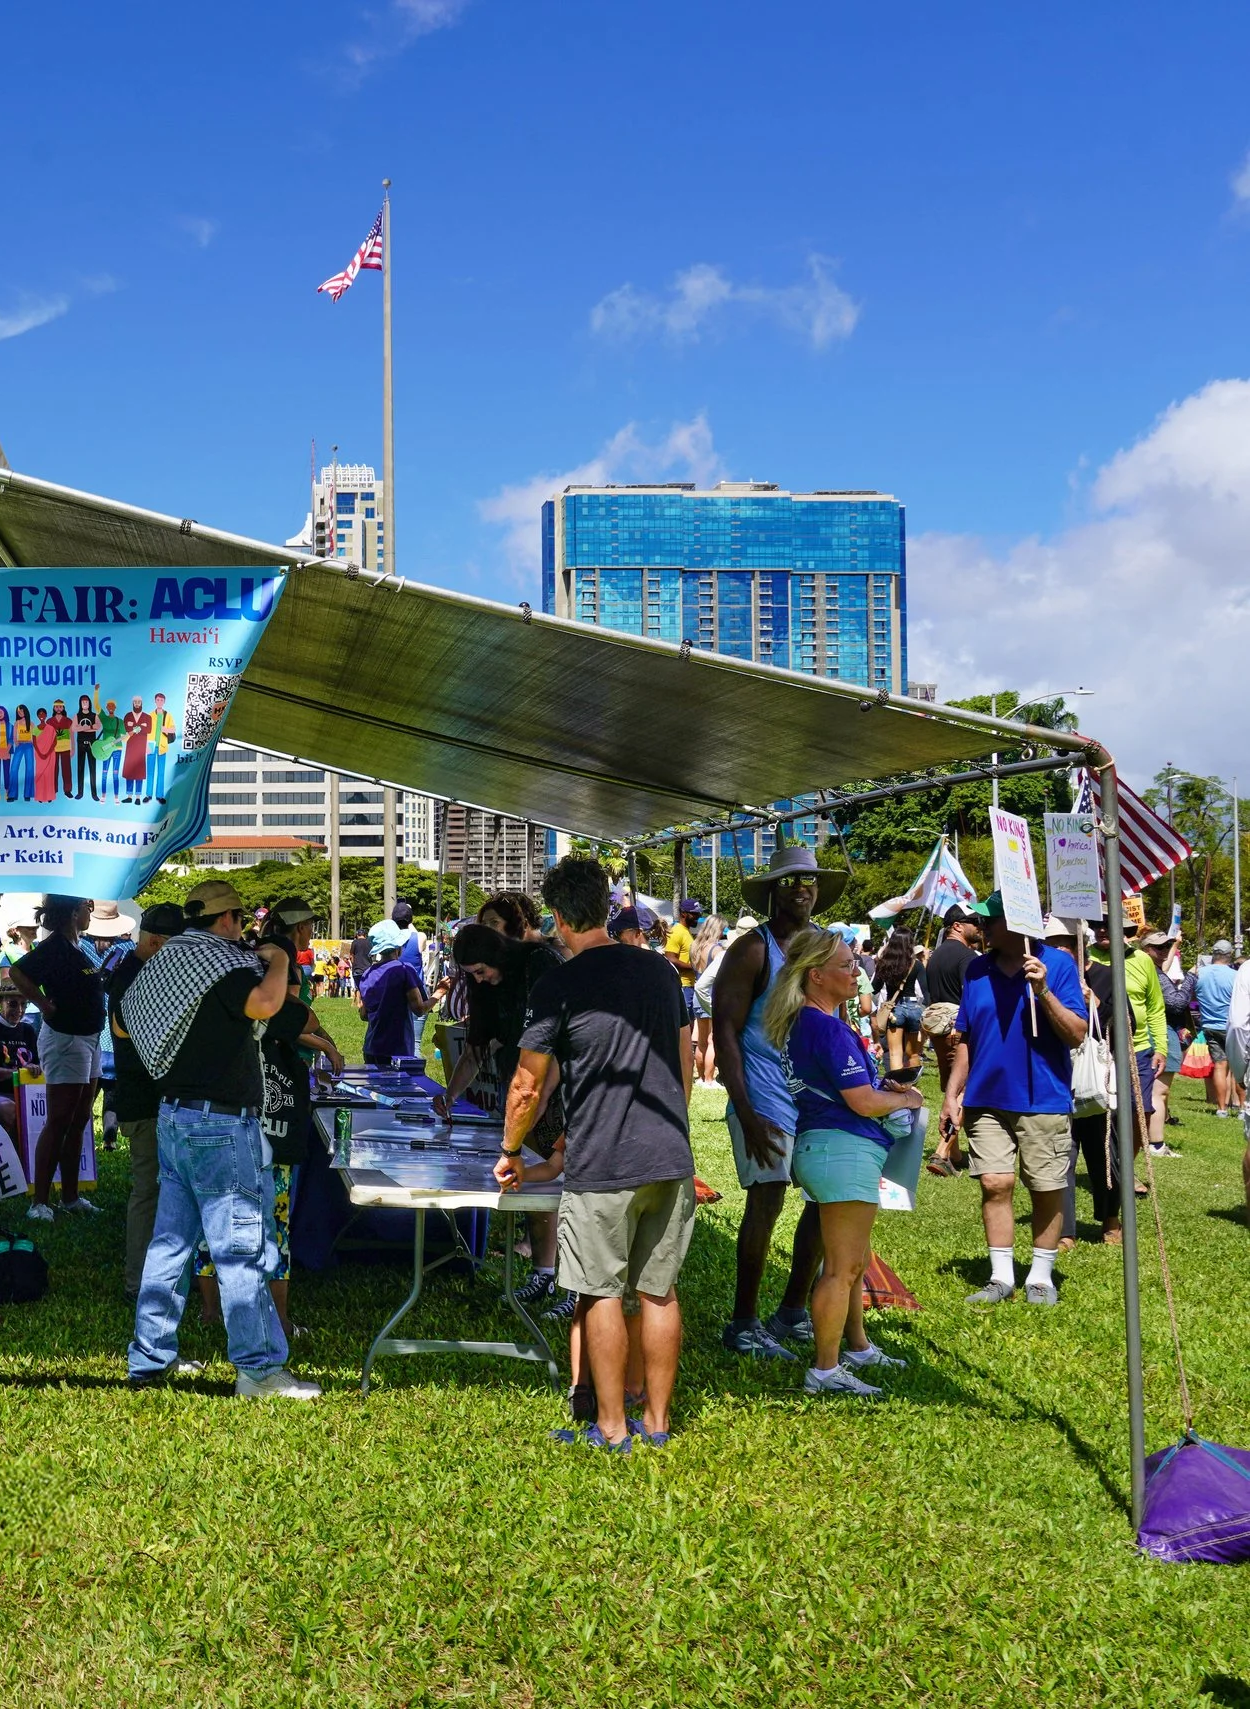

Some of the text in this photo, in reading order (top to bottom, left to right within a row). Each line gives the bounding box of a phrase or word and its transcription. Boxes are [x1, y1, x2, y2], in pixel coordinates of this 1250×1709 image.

[8, 585, 138, 624] FAIR:
[149, 577, 274, 622] ACLU
[209, 657, 243, 668] RSVP
[3, 824, 38, 840] Art,
[42, 824, 102, 842] Crafts,
[106, 831, 138, 846] and
[142, 818, 170, 846] Fod
[996, 815, 1008, 832] NO
[1052, 818, 1065, 835] NO
[15, 850, 63, 864] Keiki
[260, 1116, 288, 1138] CLU
